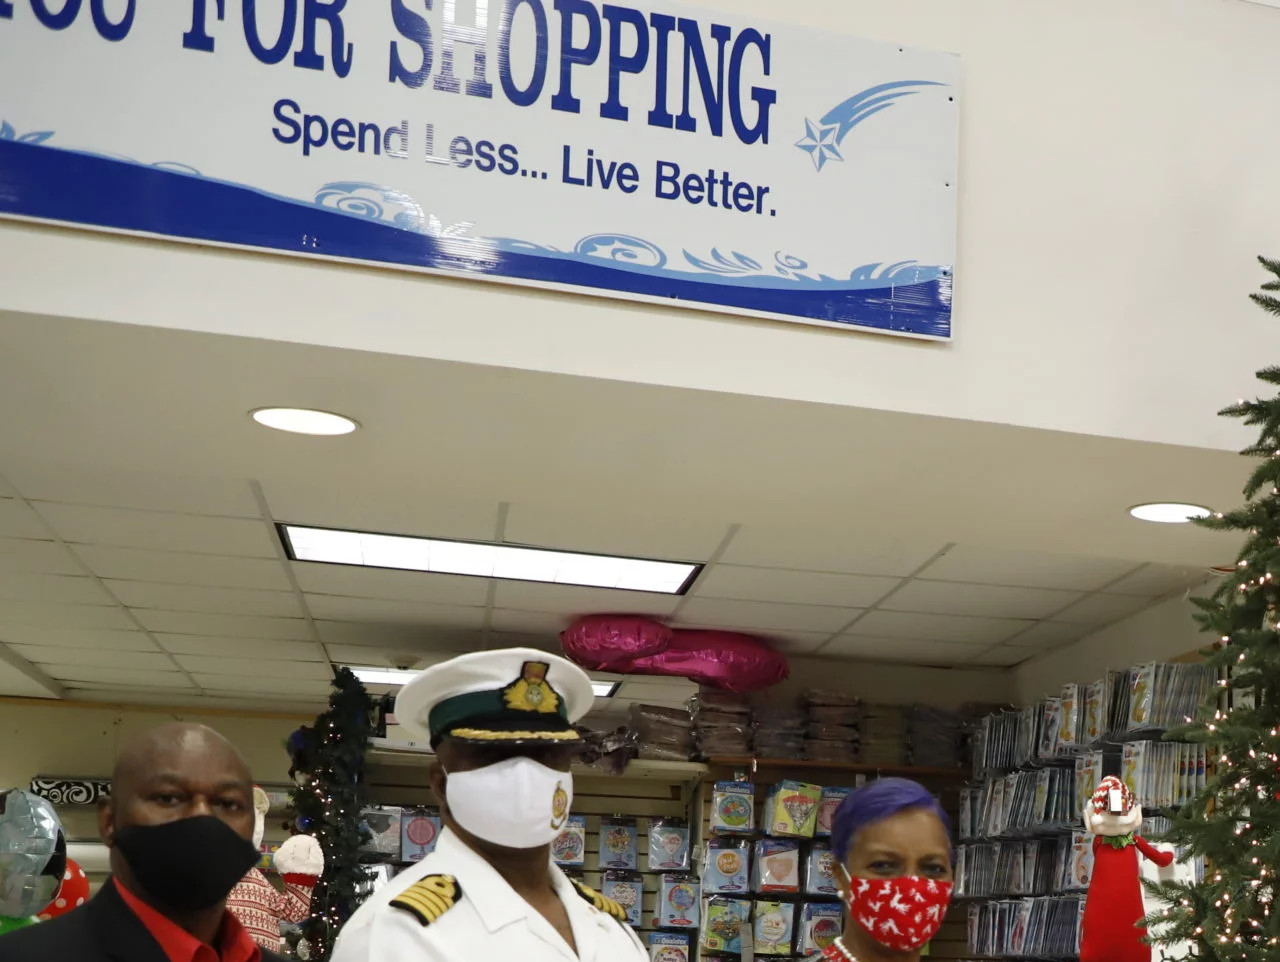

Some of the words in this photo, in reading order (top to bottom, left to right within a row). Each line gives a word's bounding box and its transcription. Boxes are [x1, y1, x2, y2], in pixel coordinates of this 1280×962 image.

[388, 0, 777, 146] SHOPPING
[271, 98, 409, 160] Spend
[424, 122, 548, 180] Less...
[562, 144, 639, 194] Live
[654, 159, 777, 217] Better.
